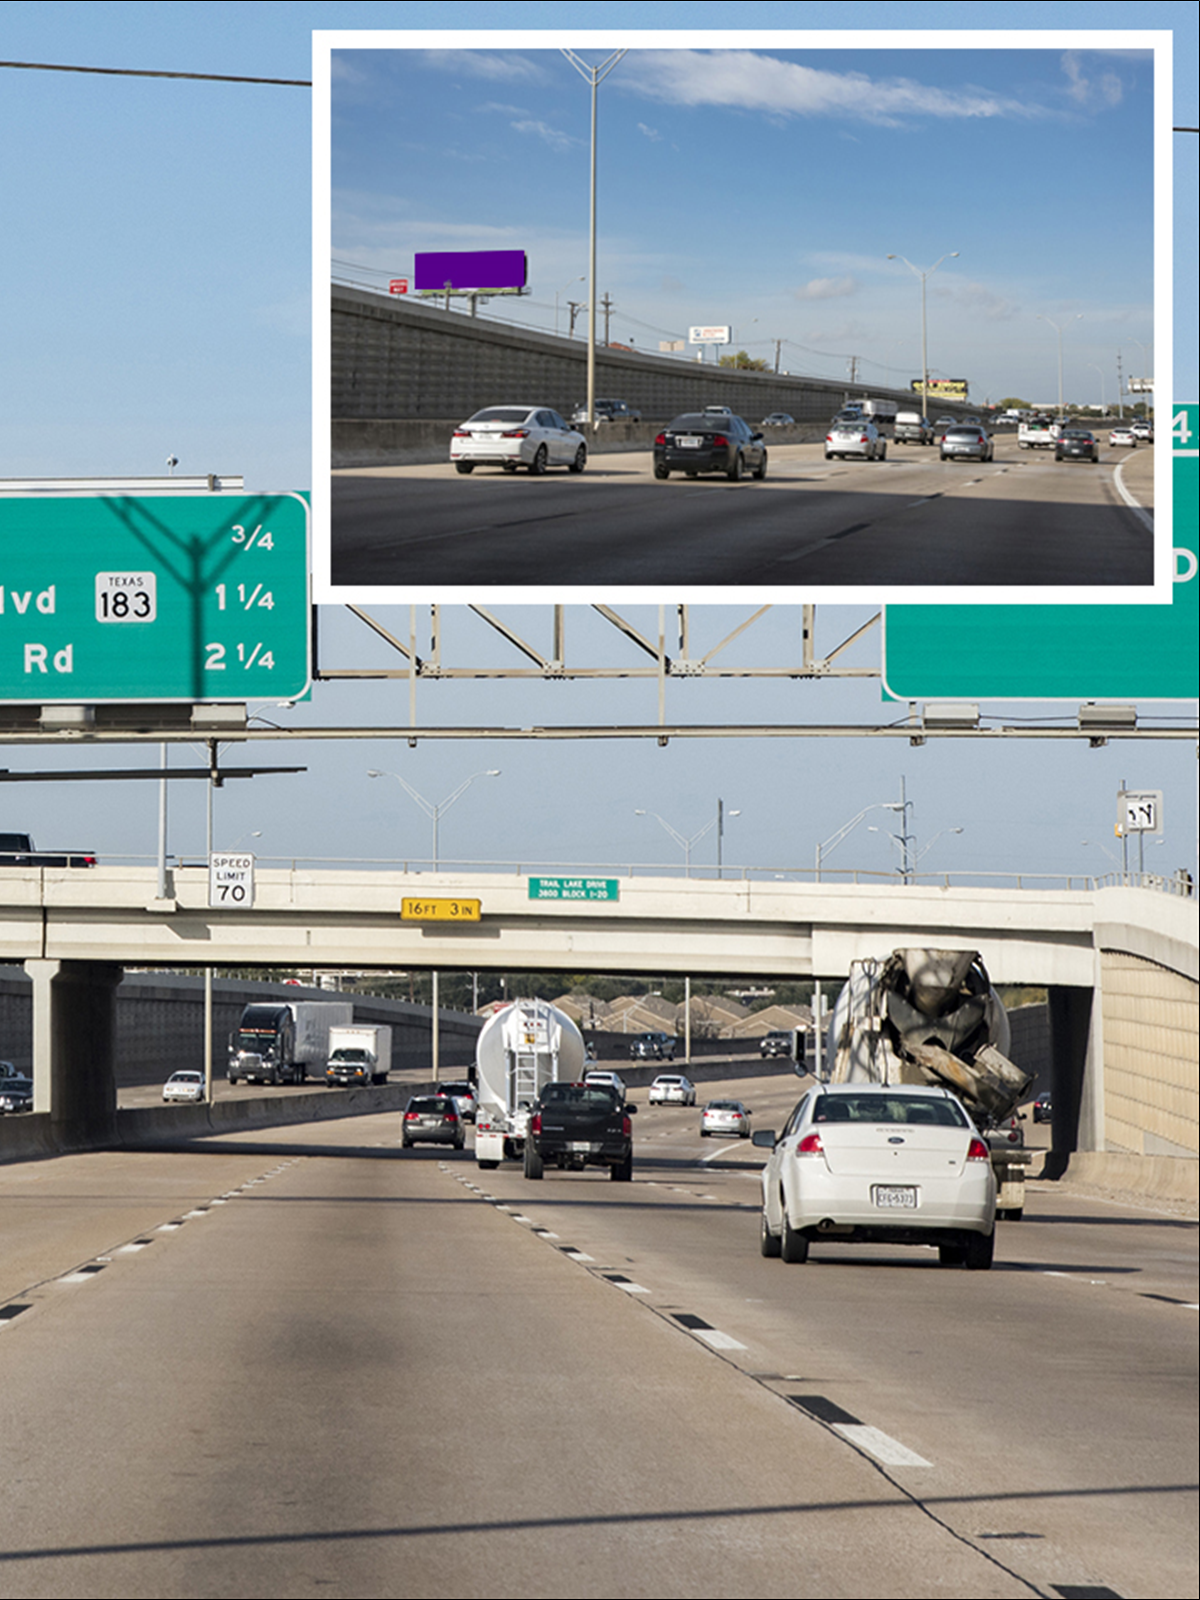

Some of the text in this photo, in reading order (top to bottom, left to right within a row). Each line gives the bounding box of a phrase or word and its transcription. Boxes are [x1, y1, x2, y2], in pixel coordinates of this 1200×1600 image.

[108, 576, 144, 587] TEXAS
[100, 591, 151, 618] 183
[23, 643, 74, 674] Rd
[213, 858, 251, 868] SPEED
[216, 871, 246, 881] LIMIT
[540, 880, 607, 889] TRAIL LAKE DRIVE
[216, 884, 246, 902] 70
[562, 889, 587, 898] BLOCK
